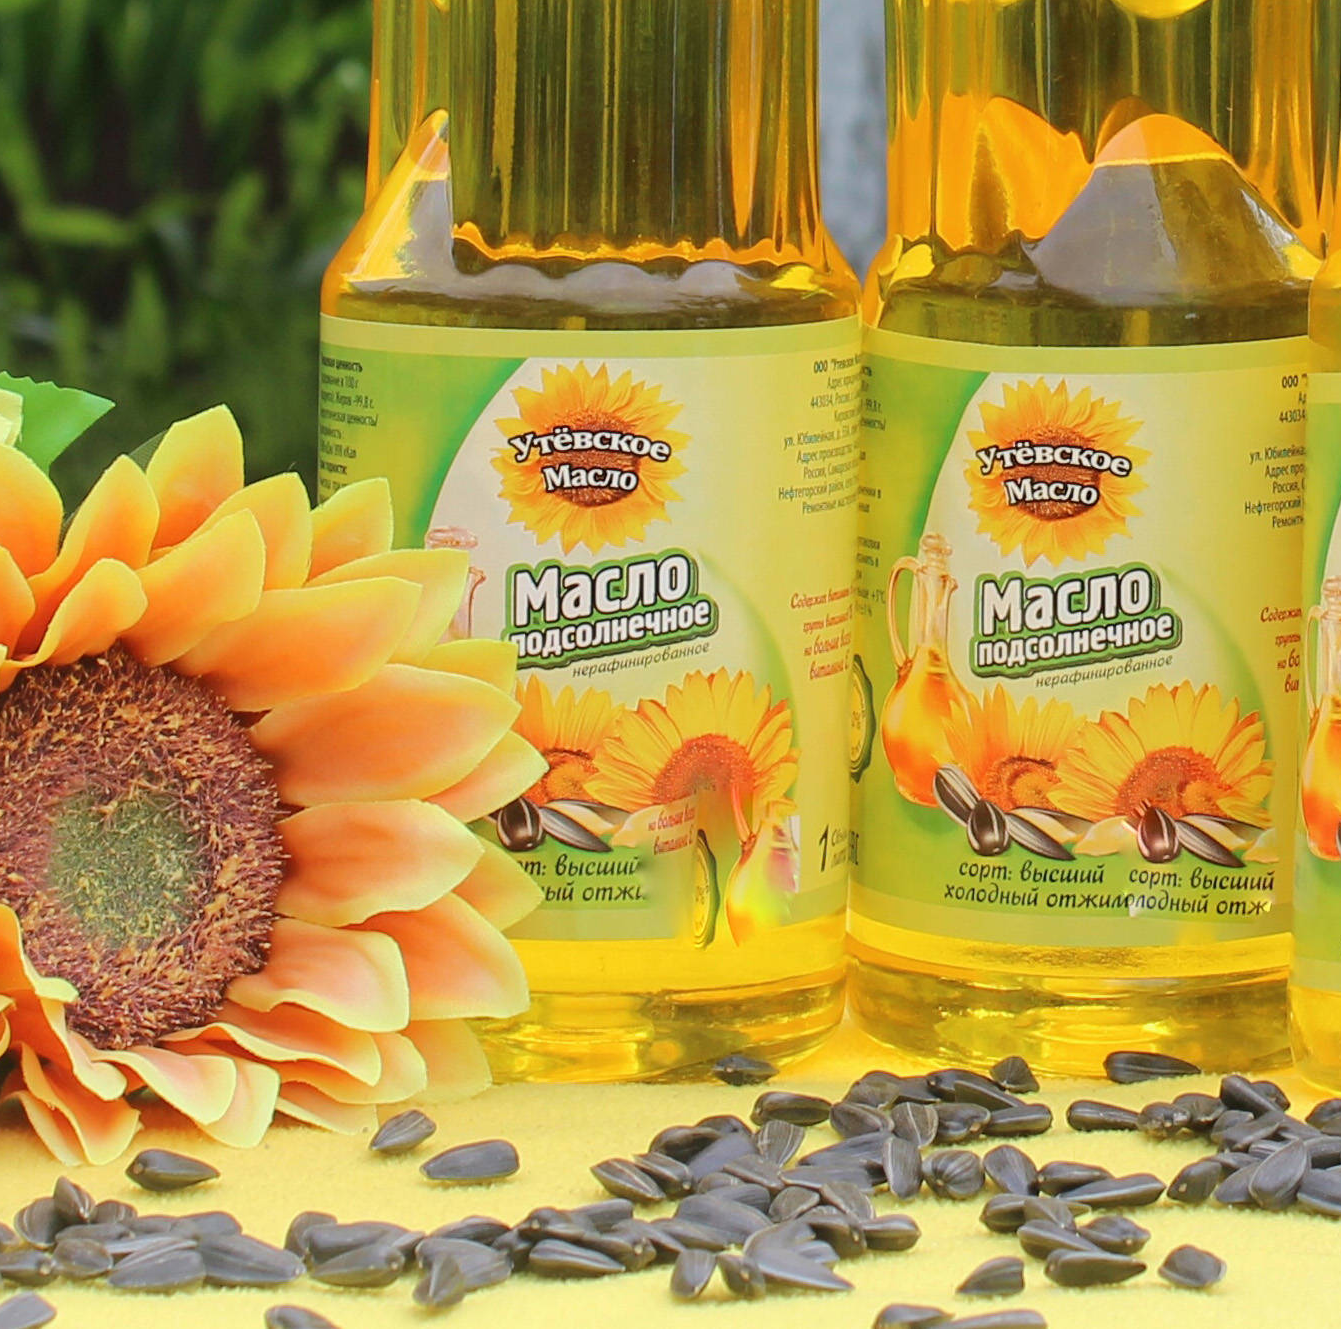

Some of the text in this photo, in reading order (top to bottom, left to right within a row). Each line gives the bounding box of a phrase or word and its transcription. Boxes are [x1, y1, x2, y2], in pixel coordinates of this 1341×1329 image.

[509, 426, 671, 462] Утёвское
[976, 439, 1132, 477] Утёвское
[1265, 445, 1306, 460] Юбилейна
[542, 464, 638, 492] Масло
[1004, 477, 1099, 507] Масло
[514, 554, 690, 627] Масло
[982, 568, 1152, 636] Масло
[511, 600, 711, 659] подсолнечное
[977, 613, 1174, 669] подсолнечное
[573, 642, 709, 678] нерафинированное
[1035, 655, 1173, 689] нерафинированное
[959, 860, 1105, 884] сорт: высший
[1129, 866, 1275, 890] сорт: высший
[944, 883, 1038, 907] холодный
